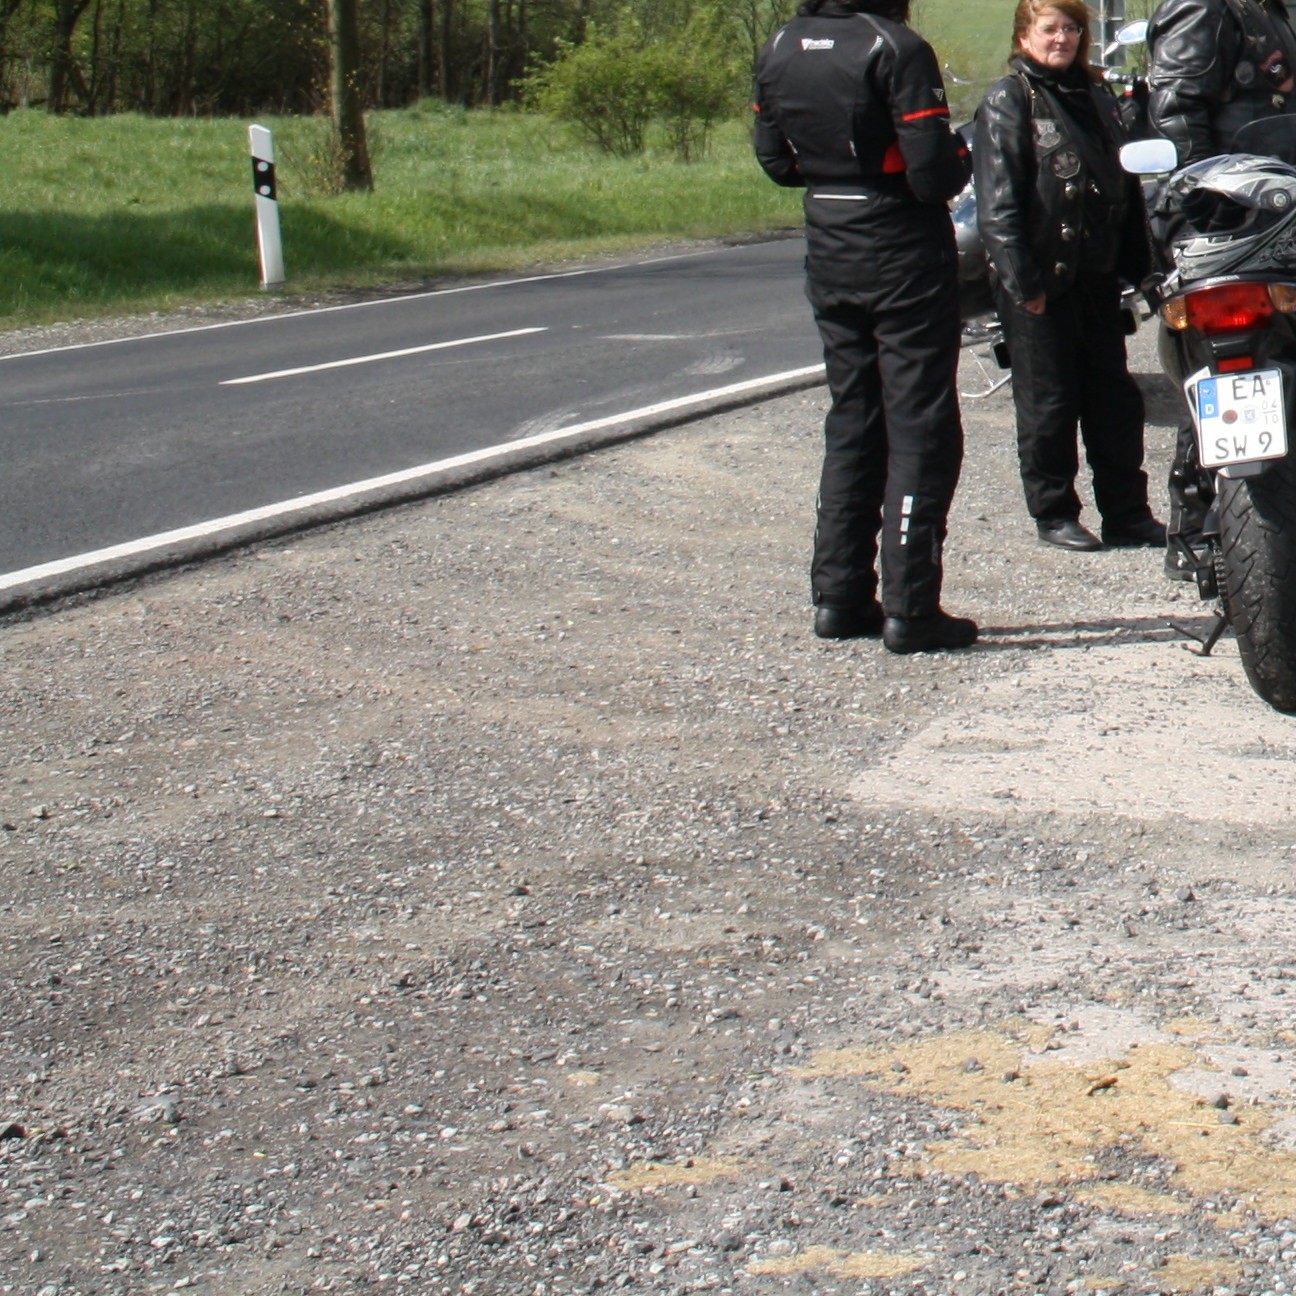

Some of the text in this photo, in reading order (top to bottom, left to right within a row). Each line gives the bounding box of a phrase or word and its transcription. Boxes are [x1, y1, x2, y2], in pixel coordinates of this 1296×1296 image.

[1232, 375, 1266, 401] EA
[1215, 431, 1272, 460] SW 9
